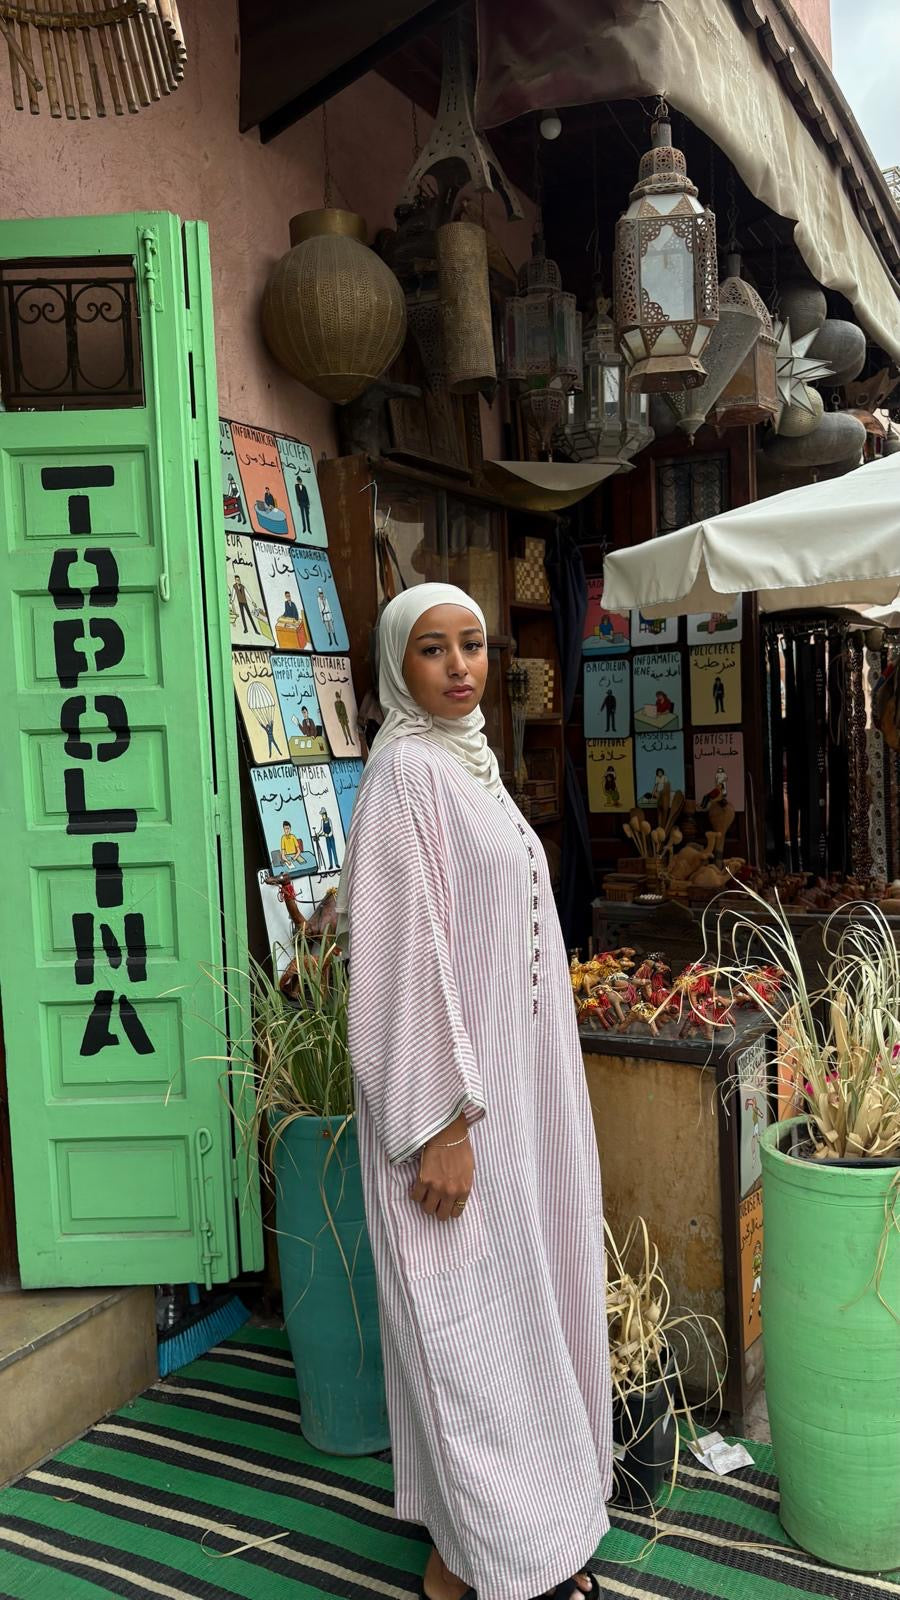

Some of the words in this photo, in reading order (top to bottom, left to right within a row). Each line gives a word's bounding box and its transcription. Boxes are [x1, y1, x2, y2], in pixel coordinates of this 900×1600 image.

[312, 657, 346, 670] MILITAIRE
[694, 732, 735, 745] DENTISTE
[41, 465, 155, 1056] TOPOLINA
